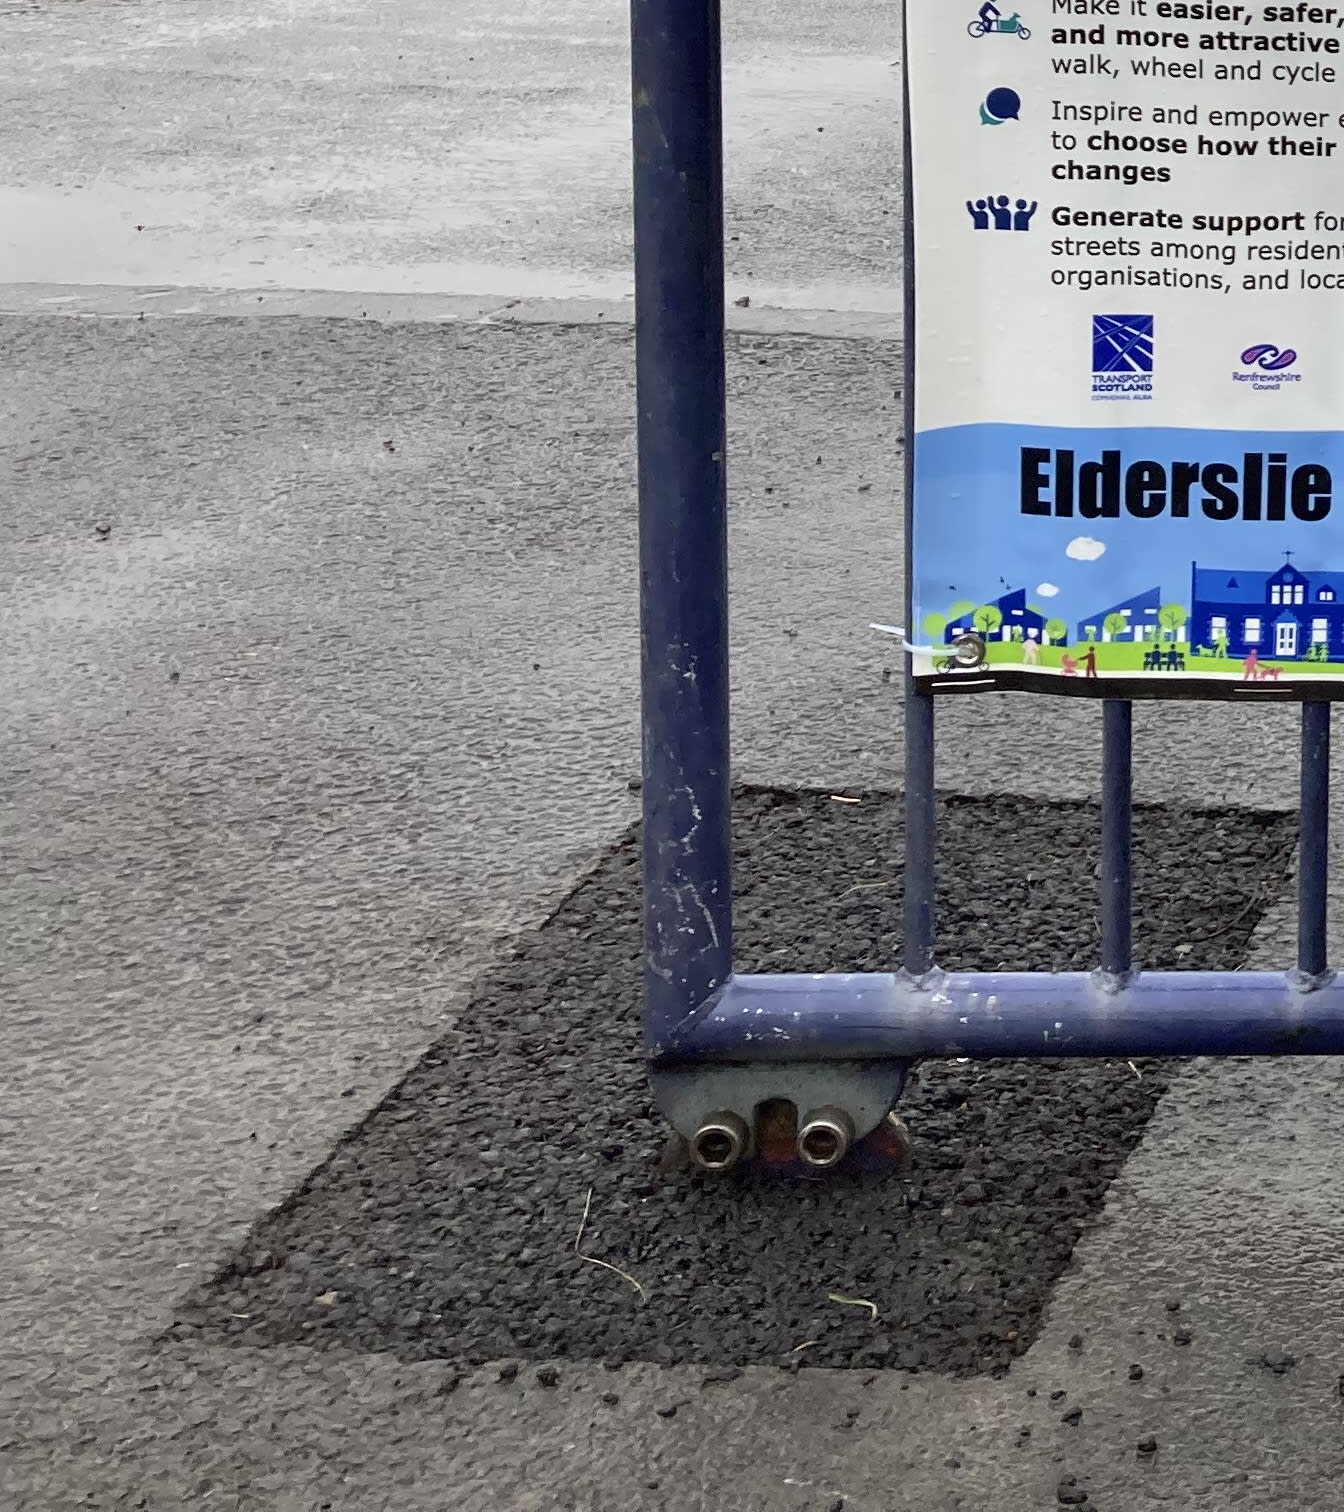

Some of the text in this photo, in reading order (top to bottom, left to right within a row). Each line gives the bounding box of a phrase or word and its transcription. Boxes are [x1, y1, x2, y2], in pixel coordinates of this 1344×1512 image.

[1051, 100, 1143, 126] Inspire
[1151, 104, 1198, 126] and
[1208, 110, 1330, 132] empower
[1051, 206, 1183, 230] Generate
[1191, 211, 1306, 237] support
[1091, 374, 1153, 383] TRANSPORT
[1232, 371, 1302, 382] Renfrewshire
[1091, 384, 1153, 392] SCOTLAND
[1252, 382, 1281, 390] Council
[1015, 445, 1333, 523] Elderslie
